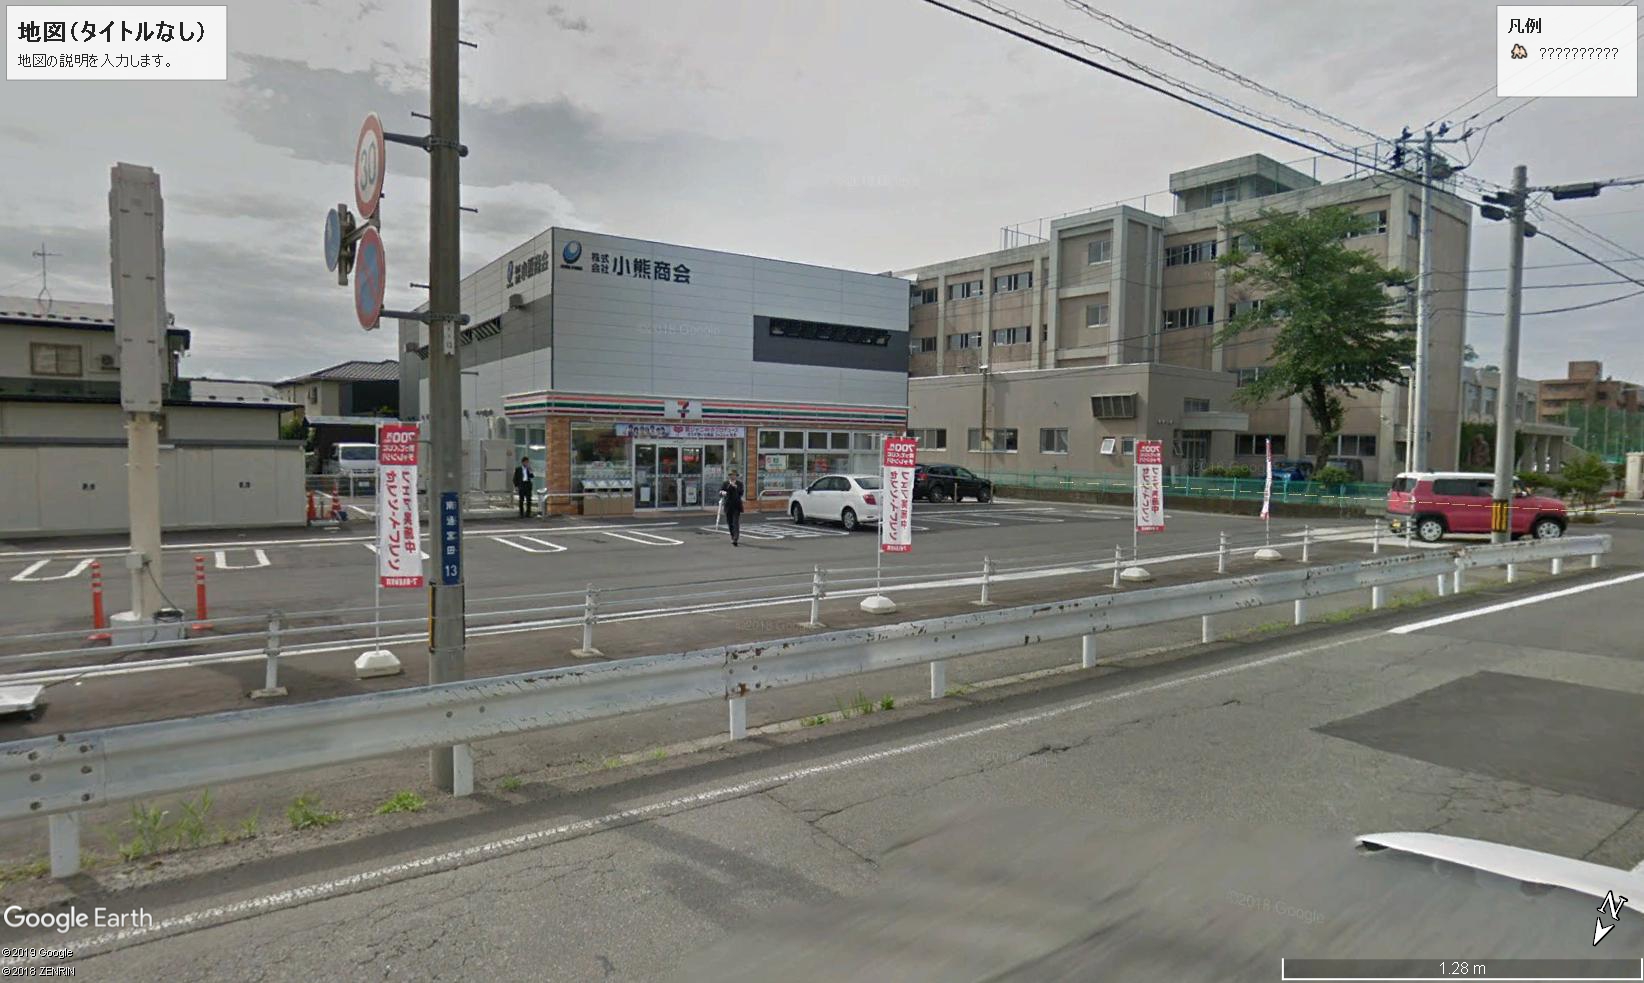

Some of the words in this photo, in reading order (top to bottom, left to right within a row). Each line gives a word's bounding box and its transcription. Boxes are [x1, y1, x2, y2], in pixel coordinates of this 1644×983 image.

[360, 143, 377, 191] 30
[612, 255, 691, 285] 小熊商会
[444, 565, 458, 577] 13
